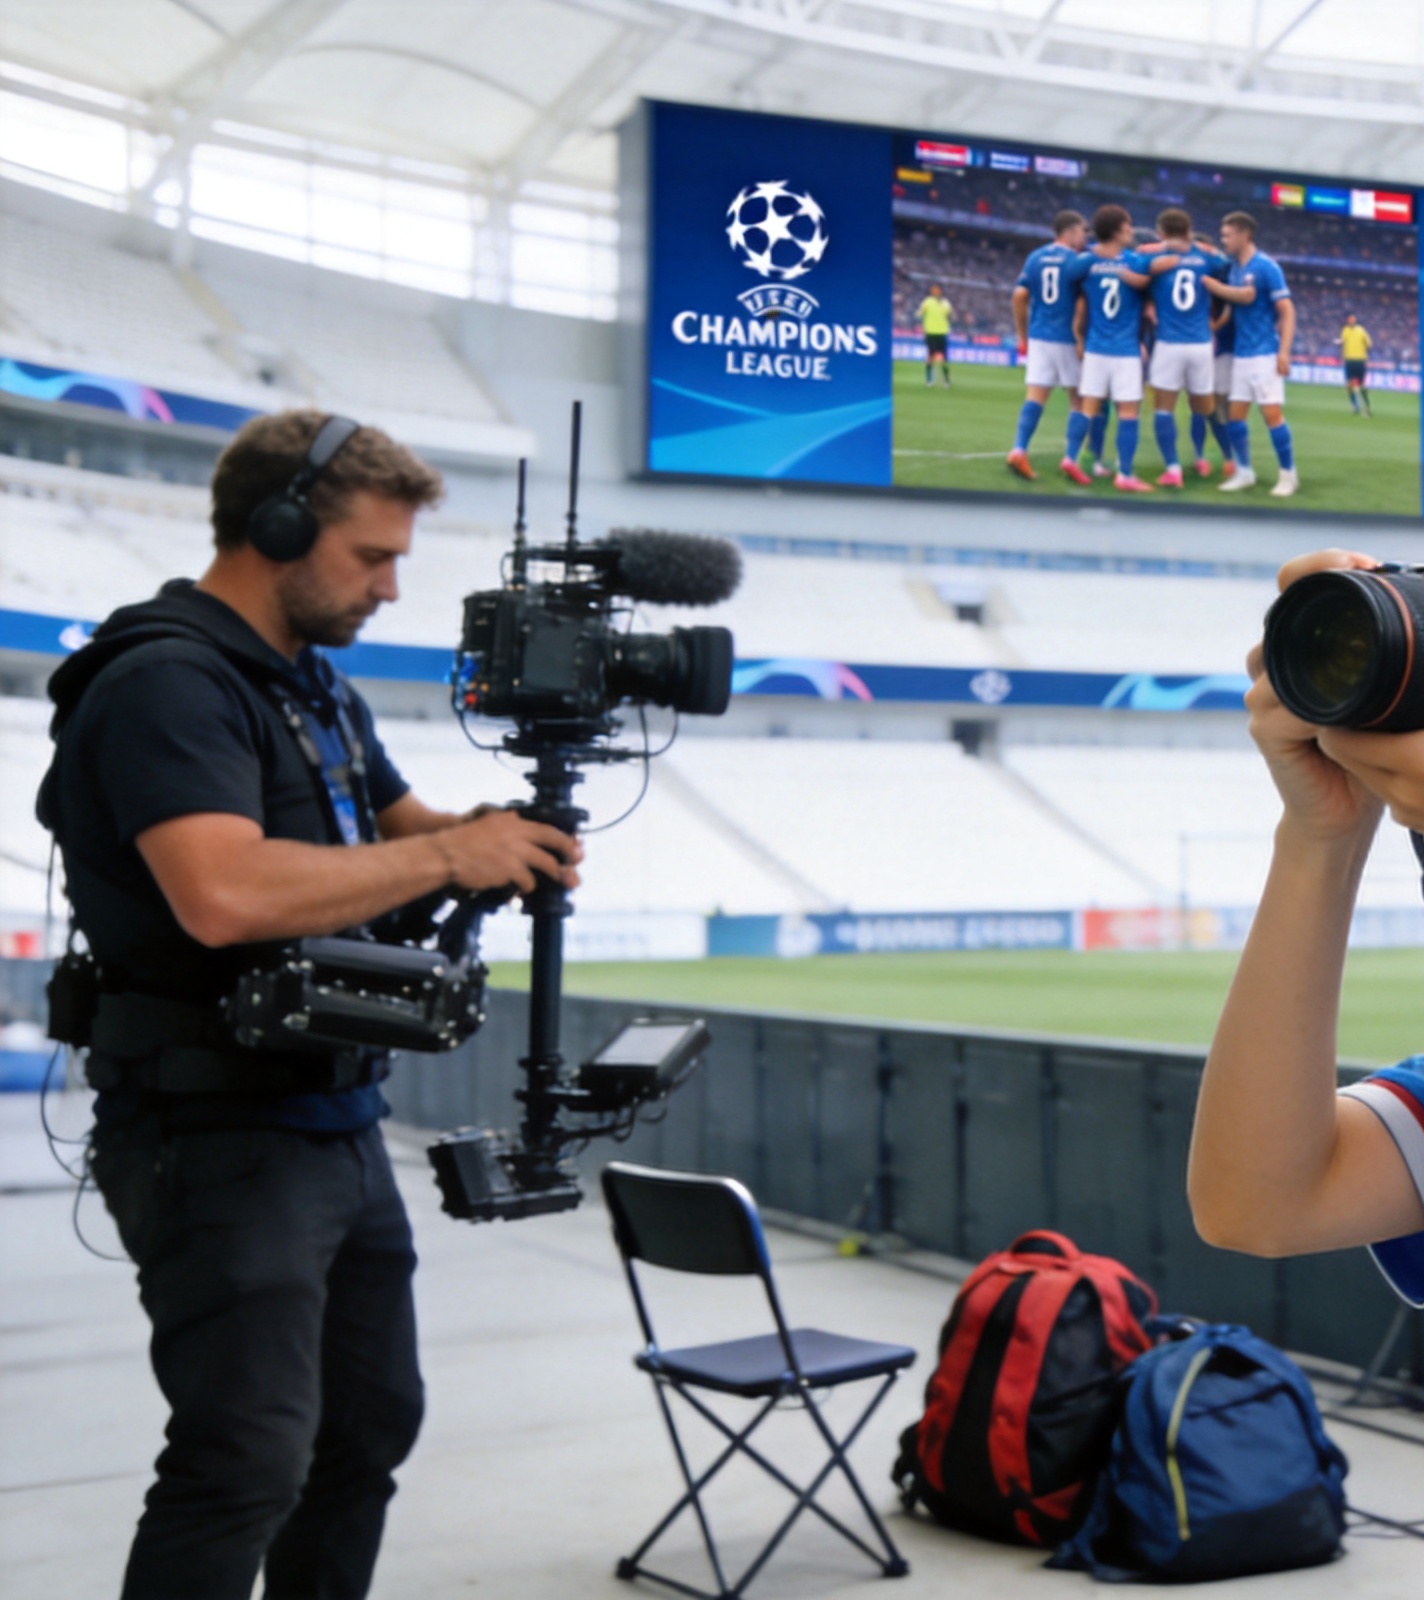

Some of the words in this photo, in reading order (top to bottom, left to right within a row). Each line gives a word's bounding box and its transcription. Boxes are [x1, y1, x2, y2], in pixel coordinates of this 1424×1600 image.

[1172, 269, 1195, 311] 6
[672, 311, 877, 356] CHAMPIONS
[726, 351, 830, 380] LEAGUE
